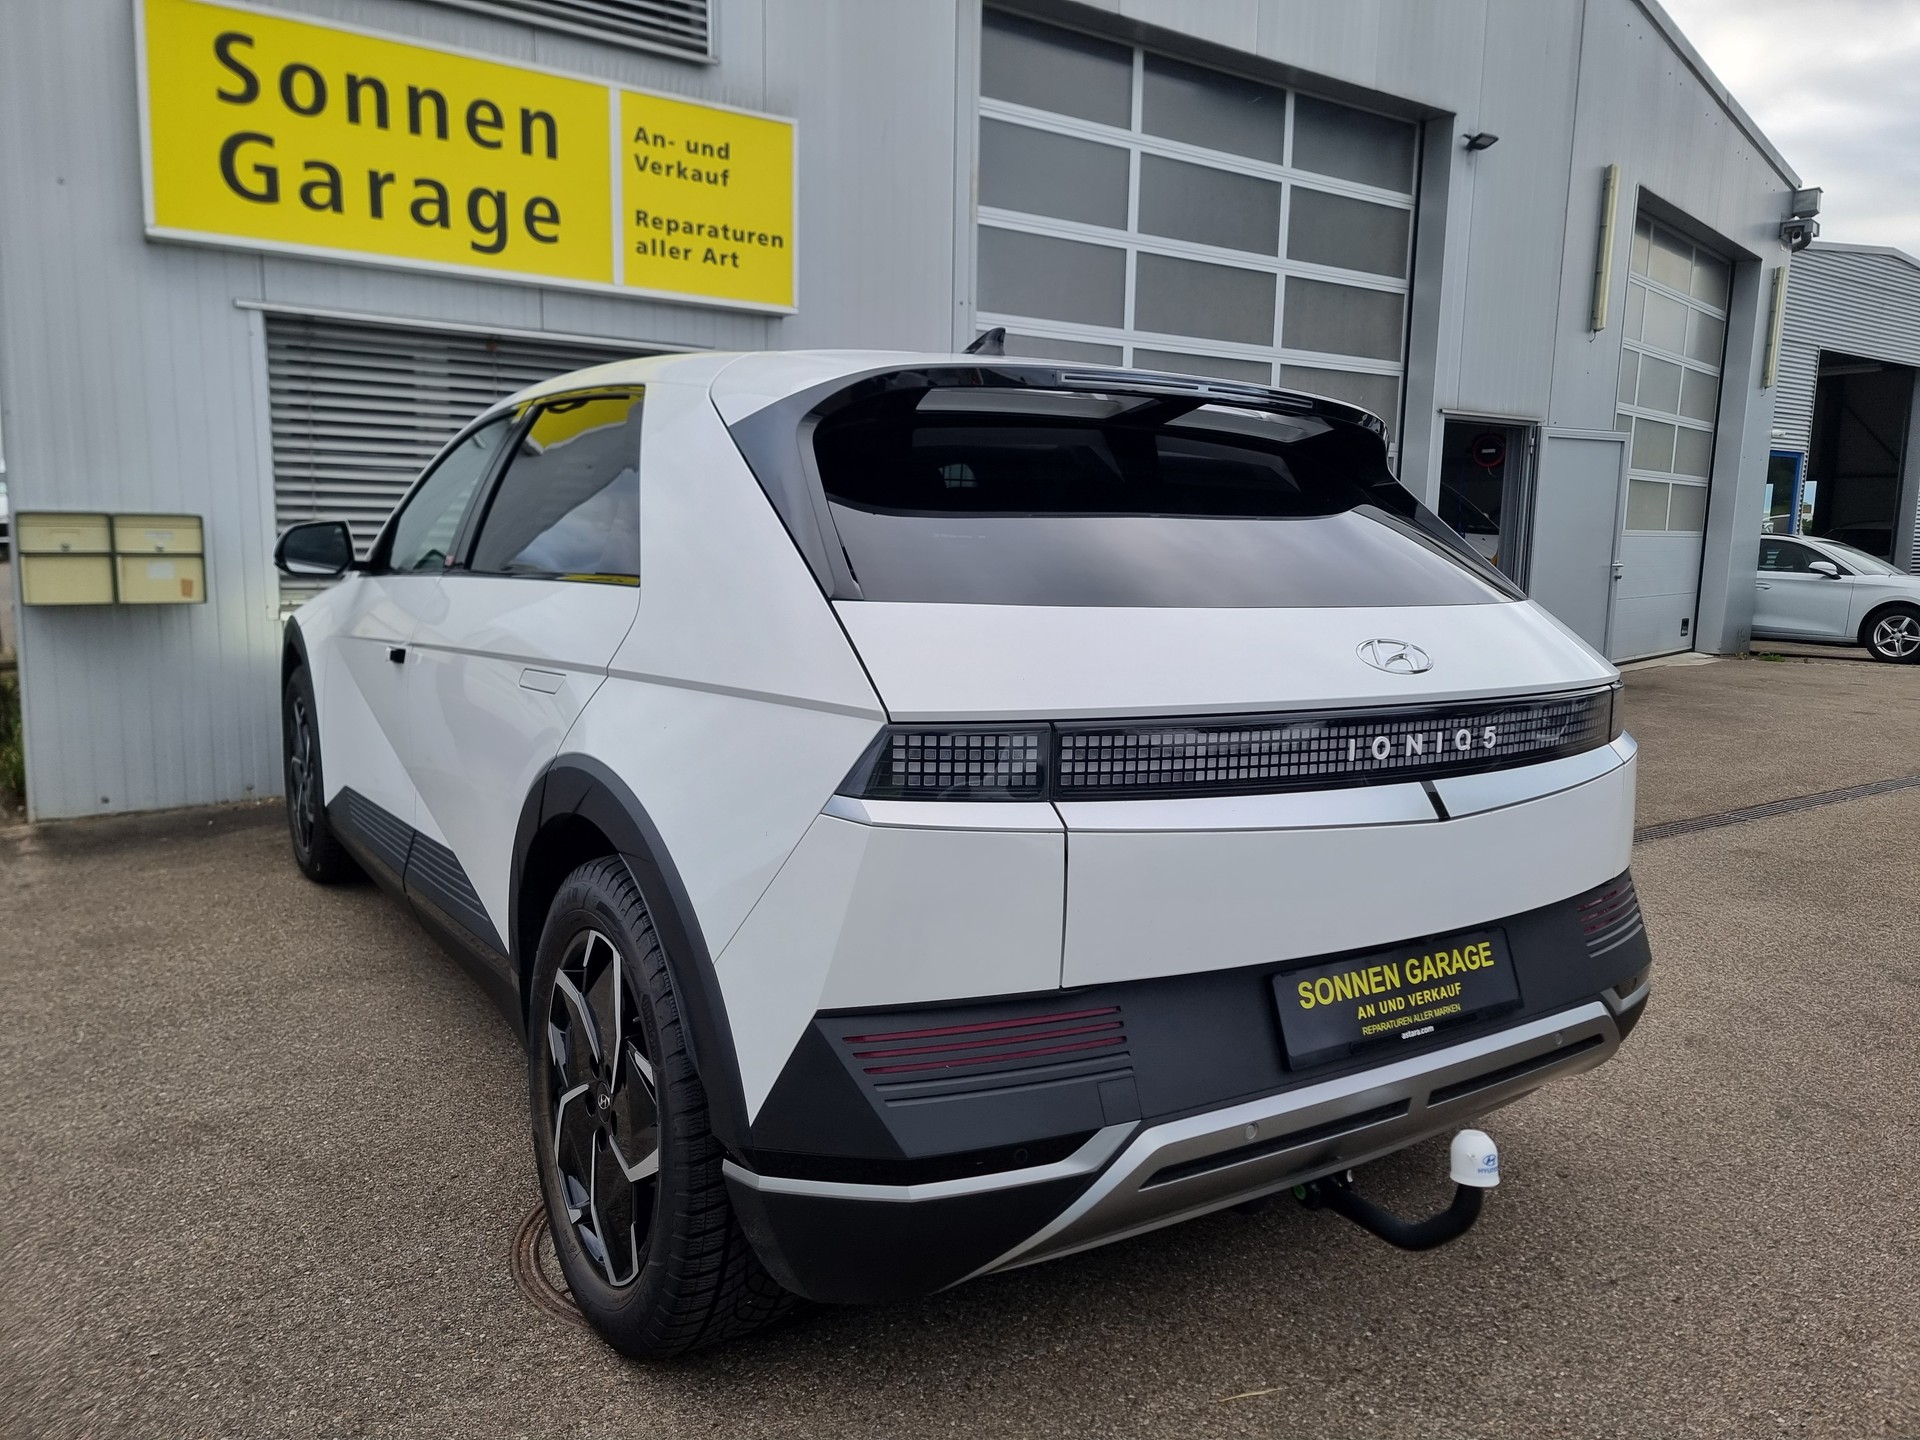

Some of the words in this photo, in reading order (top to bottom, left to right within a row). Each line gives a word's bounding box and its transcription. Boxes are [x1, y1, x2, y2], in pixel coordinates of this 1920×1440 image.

[213, 30, 559, 160] Sonnen
[634, 126, 675, 148] An-
[686, 139, 730, 160] und
[634, 153, 730, 187] Verkauf
[218, 130, 561, 255] Garage
[635, 209, 784, 249] Reparaturen
[636, 238, 692, 260] aller
[702, 248, 739, 268] Art
[1349, 729, 1471, 761] IONIQ
[1483, 726, 1497, 748] 5
[1298, 962, 1401, 1009] SONNEN
[1405, 941, 1494, 984] GARAGE
[1357, 1003, 1376, 1020] AN
[1379, 996, 1405, 1014] UND
[1407, 982, 1462, 1007] VERKAUF
[1362, 1016, 1413, 1035] REPARATUREN
[1413, 1009, 1434, 1022] ALLER
[1433, 1003, 1461, 1017] MARKEN
[1401, 1025, 1434, 1039] astara.com
